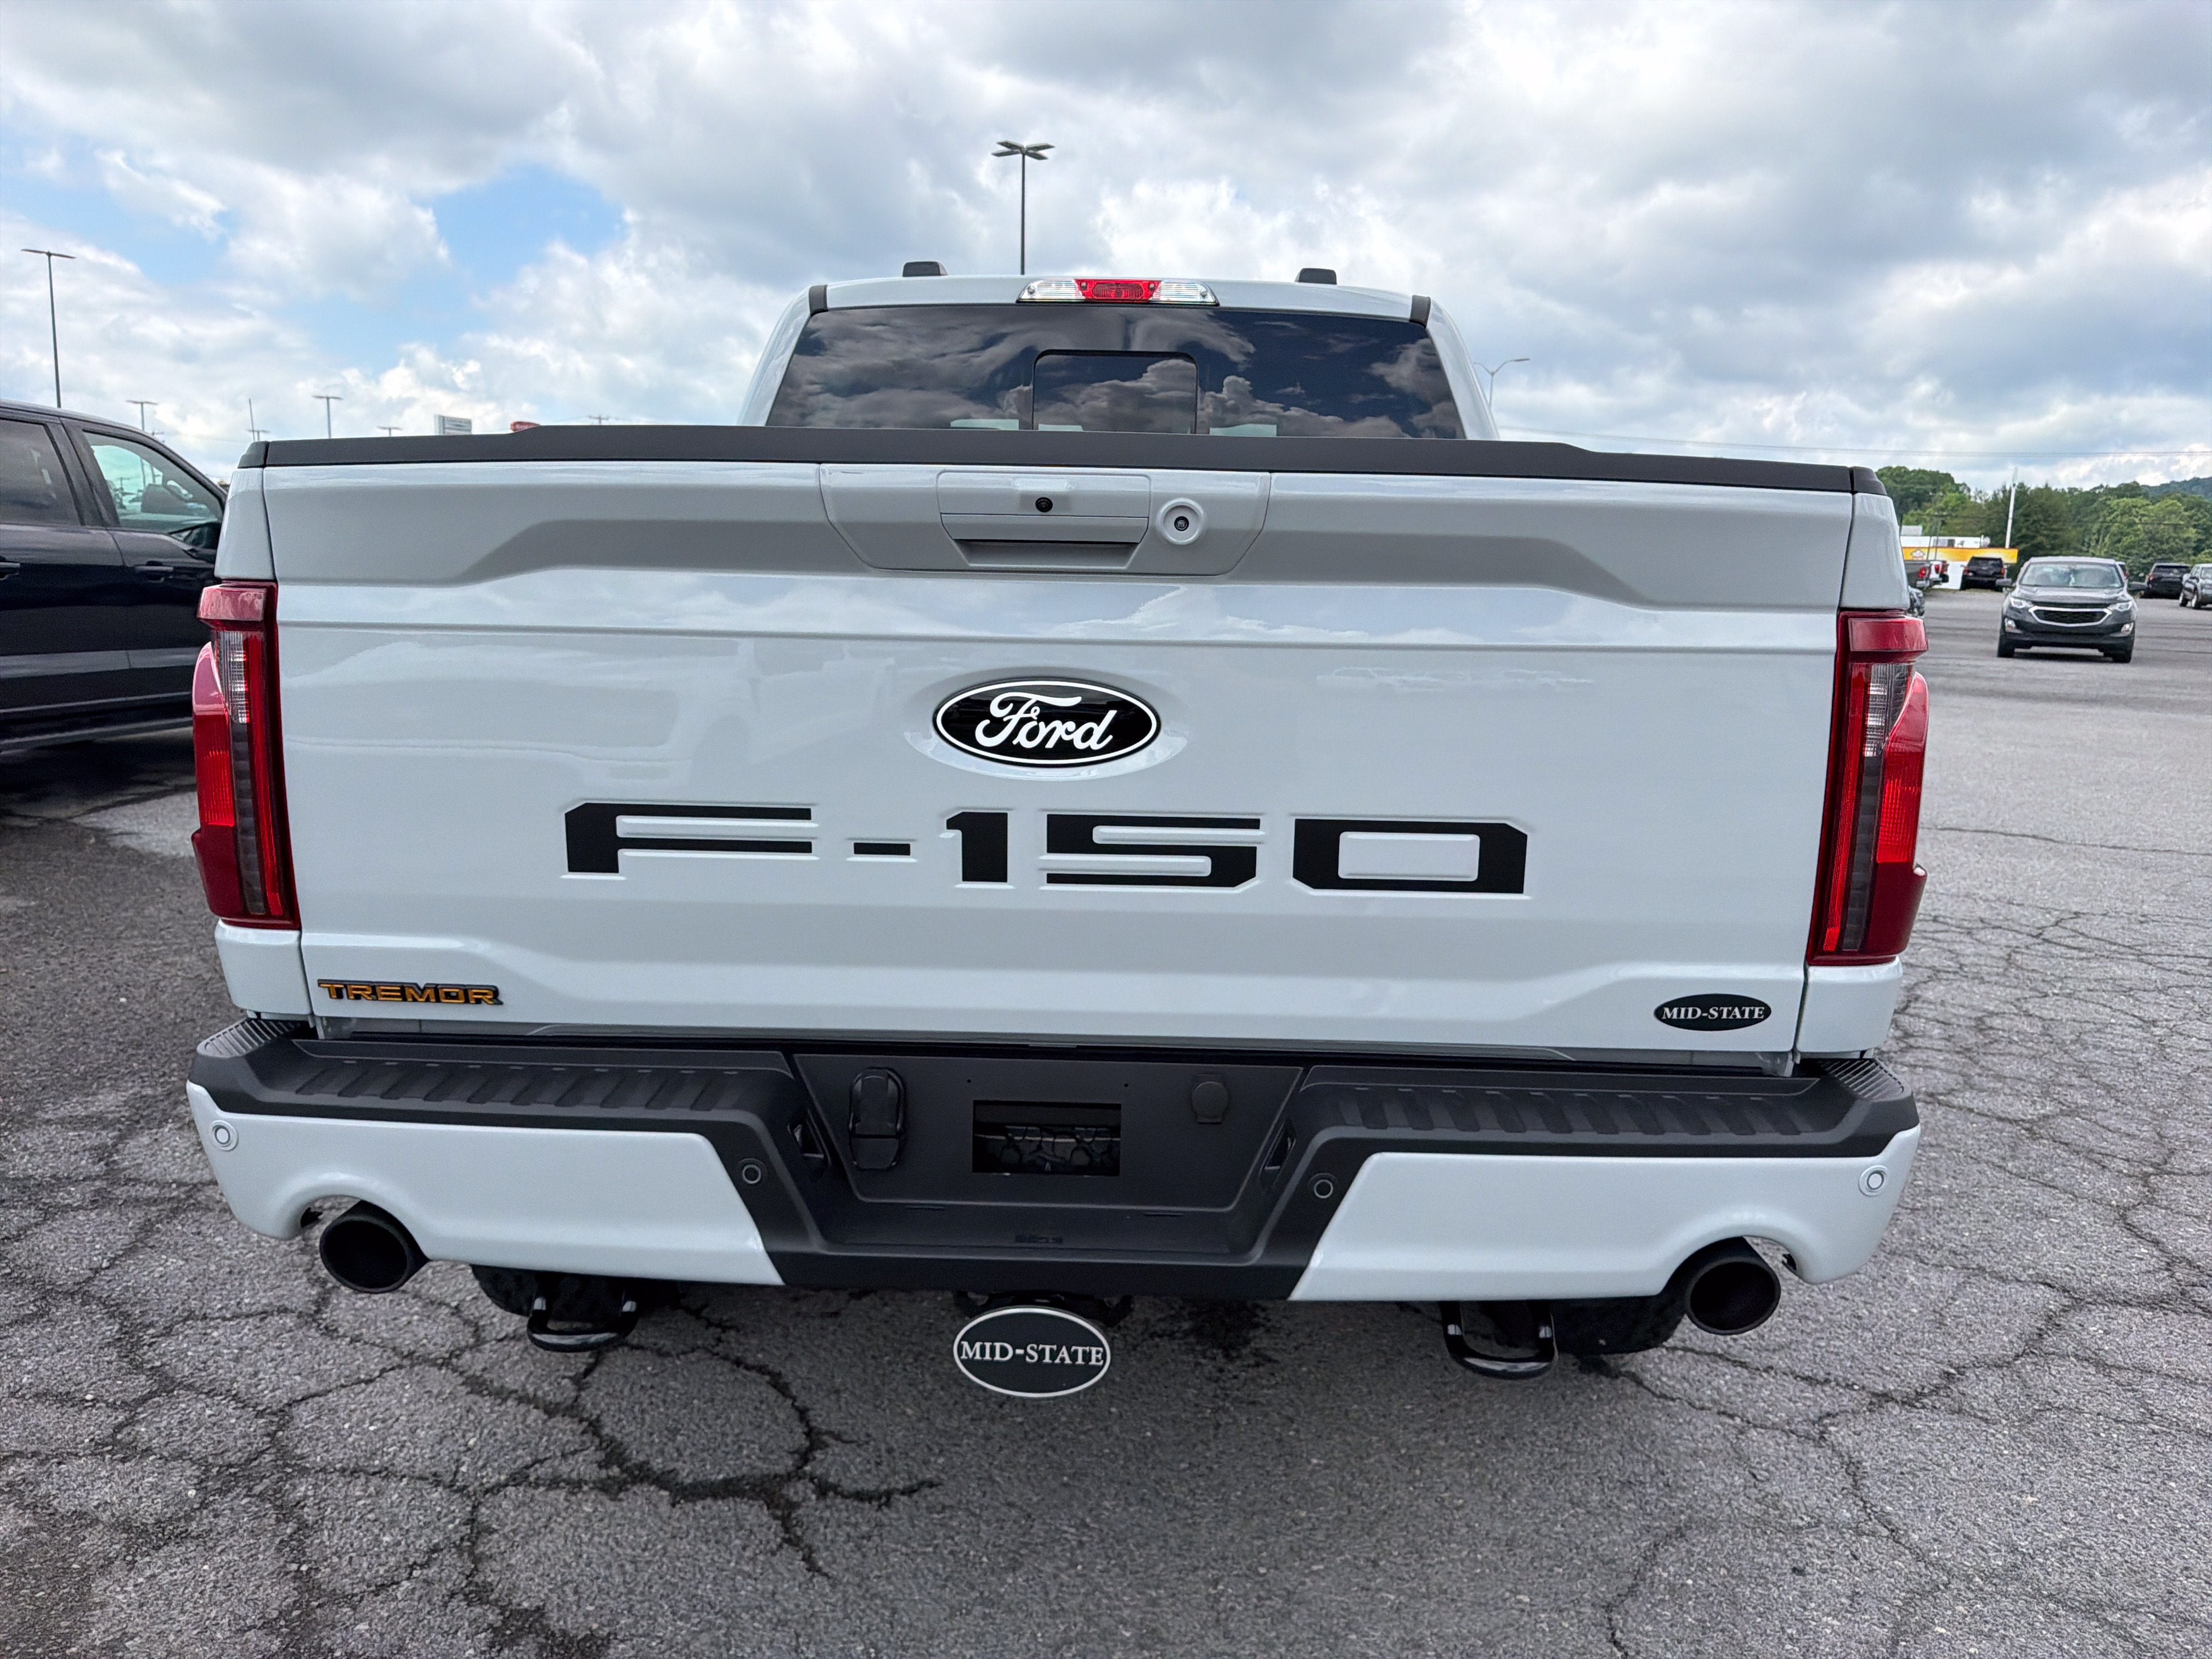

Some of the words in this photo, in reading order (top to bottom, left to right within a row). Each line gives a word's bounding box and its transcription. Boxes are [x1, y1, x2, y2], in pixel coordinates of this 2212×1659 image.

[974, 691, 1118, 750] Ford
[564, 802, 1529, 894] F-150
[318, 979, 503, 1005] TREMOR
[1661, 1006, 1765, 1019] MID-STATE
[960, 1341, 1104, 1365] MID-STATE
